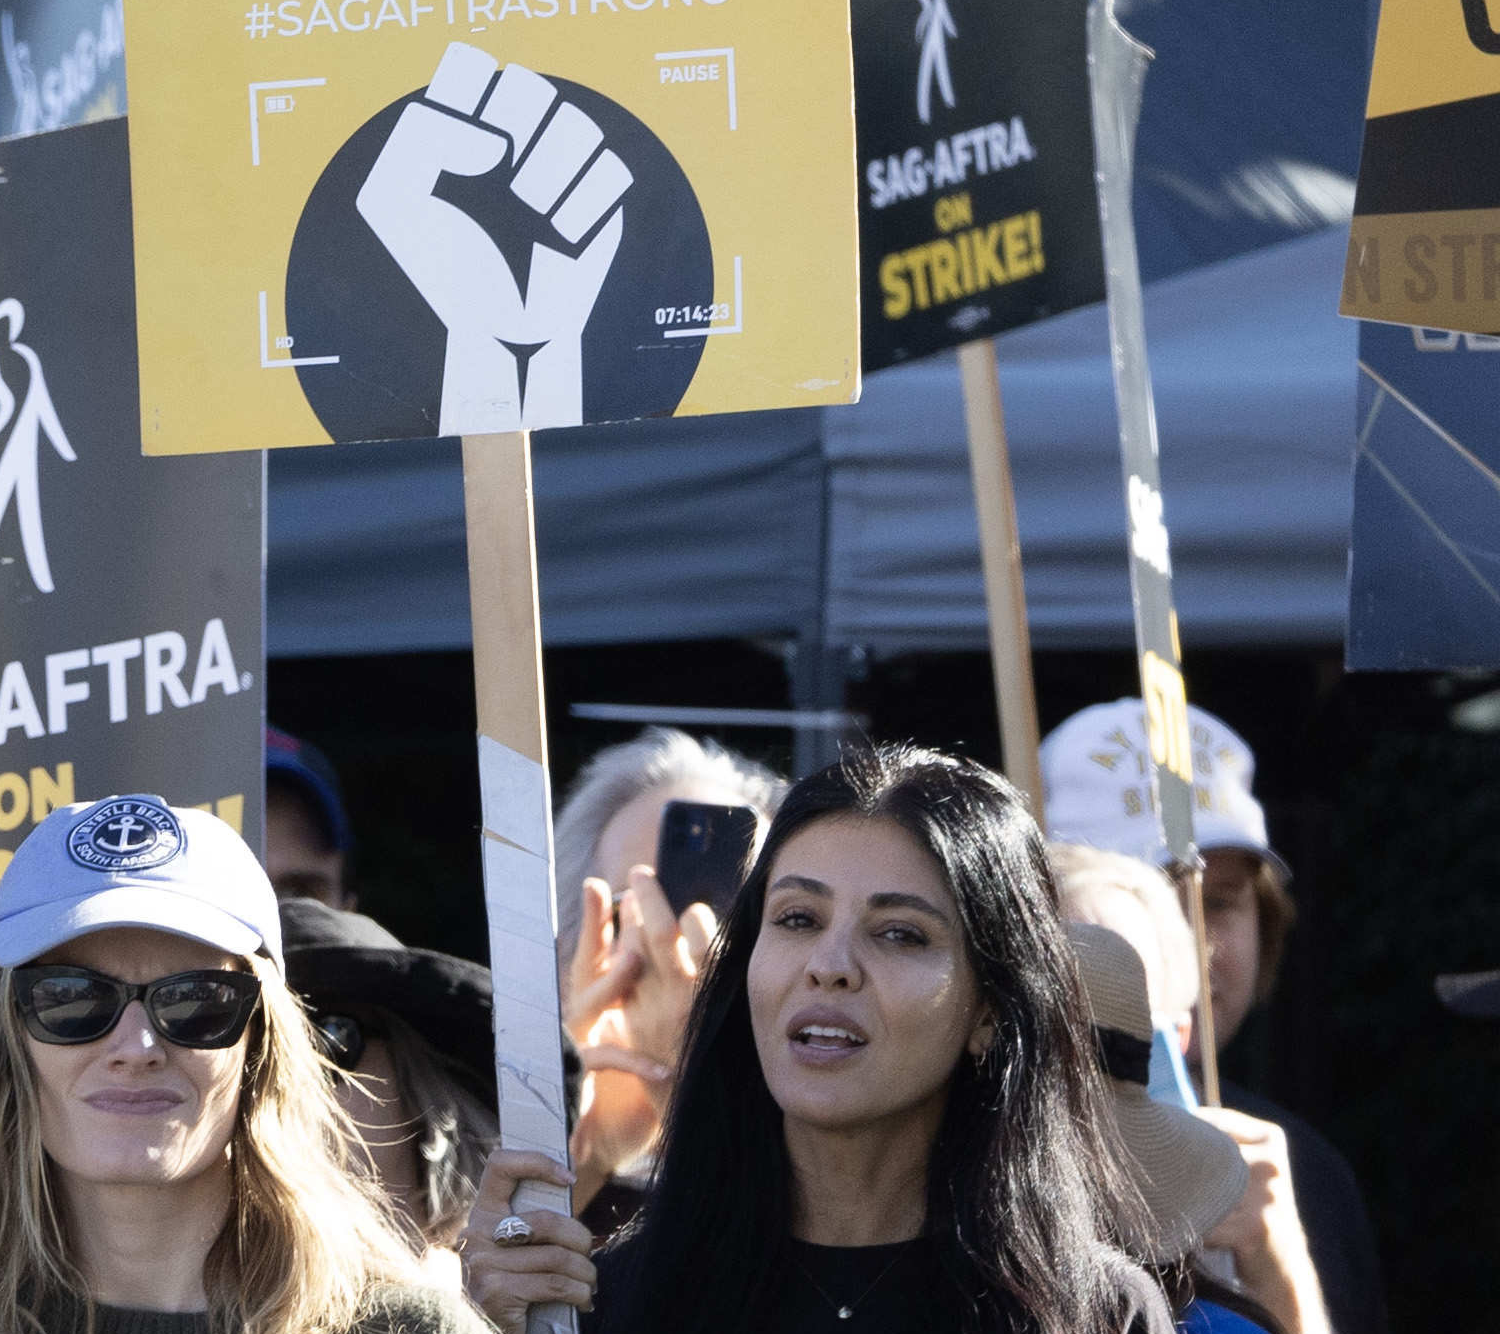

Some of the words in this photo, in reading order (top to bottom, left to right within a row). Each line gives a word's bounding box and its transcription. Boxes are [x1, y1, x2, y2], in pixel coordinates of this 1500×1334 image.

[659, 63, 721, 85] PAUSE
[933, 190, 973, 233] ON
[878, 208, 1046, 321] STRIKE!
[654, 303, 732, 326] 07:14:23
[275, 335, 295, 350] HD
[135, 805, 175, 837] BEAC
